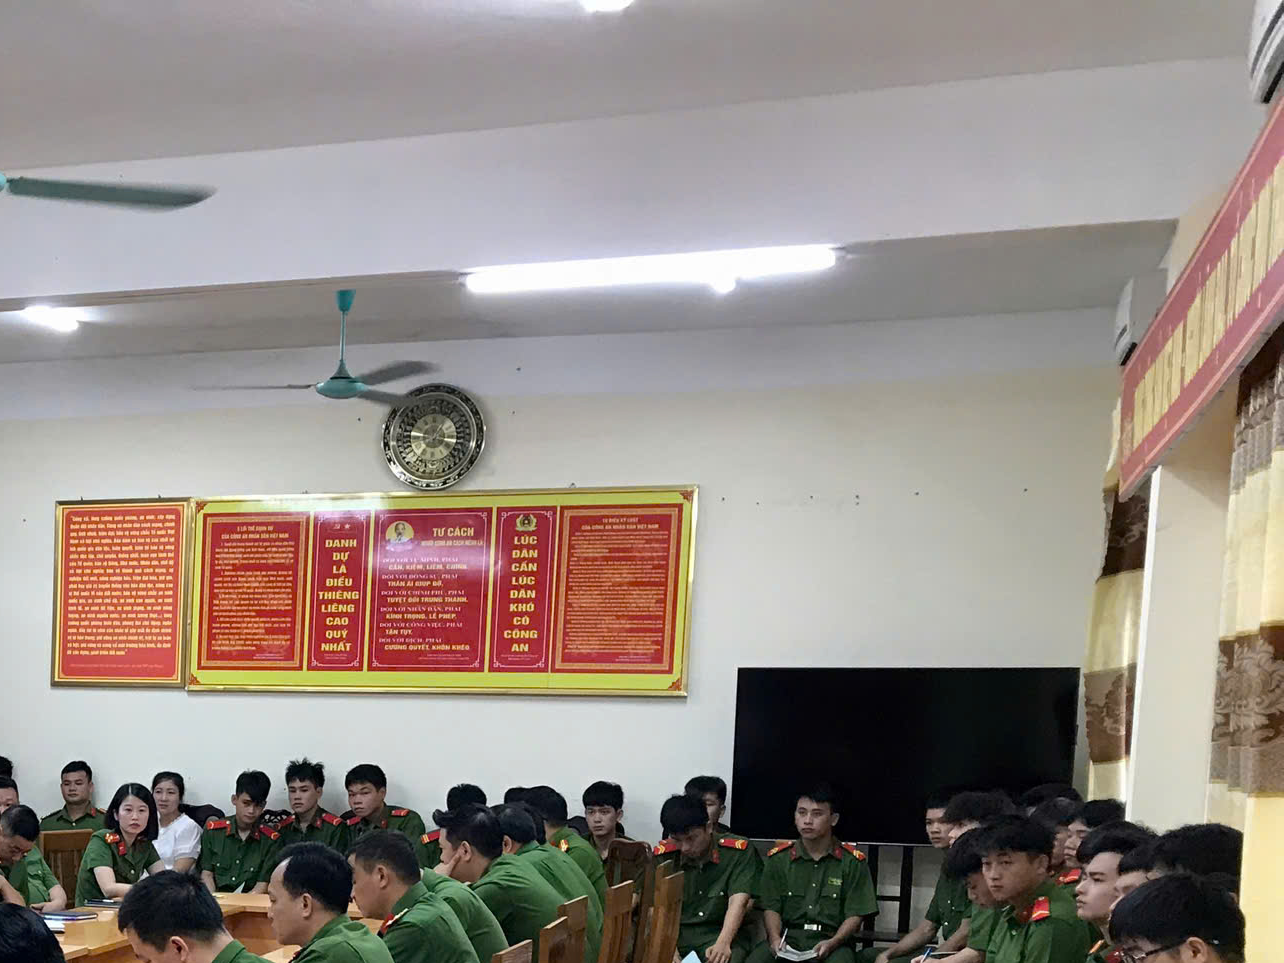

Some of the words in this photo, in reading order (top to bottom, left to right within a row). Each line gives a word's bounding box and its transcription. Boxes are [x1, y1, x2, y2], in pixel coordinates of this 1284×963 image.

[432, 527, 445, 537] TƯ
[447, 526, 474, 537] CÁCH
[325, 539, 357, 547] DANH
[514, 534, 538, 545] LÚC
[332, 551, 350, 562] DỰ
[512, 548, 538, 558] DÂN
[332, 563, 347, 573] LÀ
[511, 574, 535, 585] LÚC
[318, 589, 360, 600] THIÊNG
[510, 588, 536, 599] DÂN
[321, 602, 355, 613] LIÊNG
[510, 602, 535, 612] KHÓ
[326, 617, 349, 626] CAO
[513, 615, 530, 625] CÓ
[325, 628, 348, 639] QUÝ
[504, 628, 538, 639] CÔNG
[321, 640, 352, 652] NHẤT
[511, 643, 529, 652] AN
